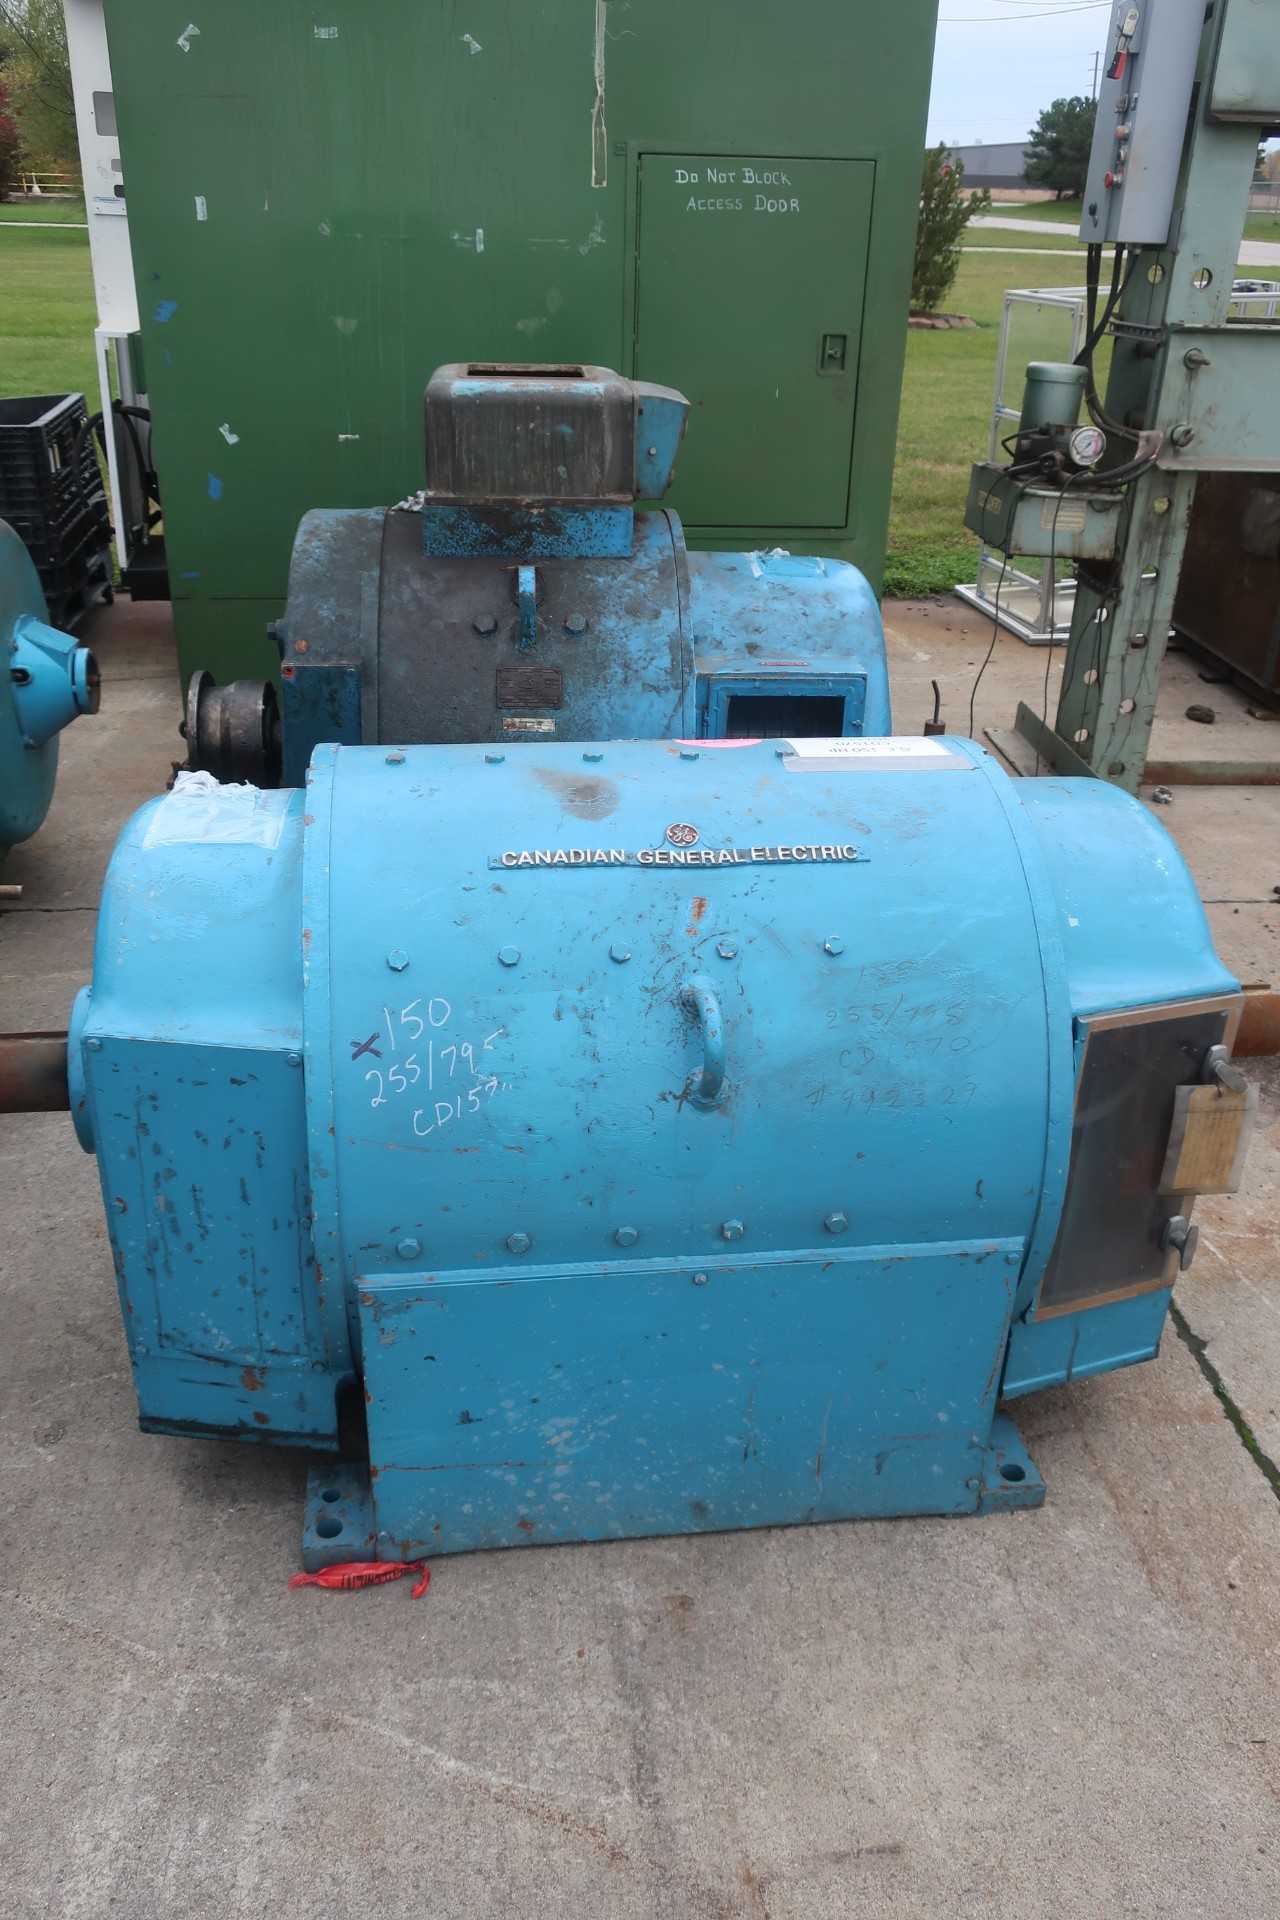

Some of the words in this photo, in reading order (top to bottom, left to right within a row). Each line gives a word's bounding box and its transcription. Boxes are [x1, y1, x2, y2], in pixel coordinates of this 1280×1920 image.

[501, 848, 626, 866] CANADIAN
[637, 849, 747, 865] GENERAL
[751, 844, 858, 861] ELECTRIC
[383, 998, 452, 1050] 150
